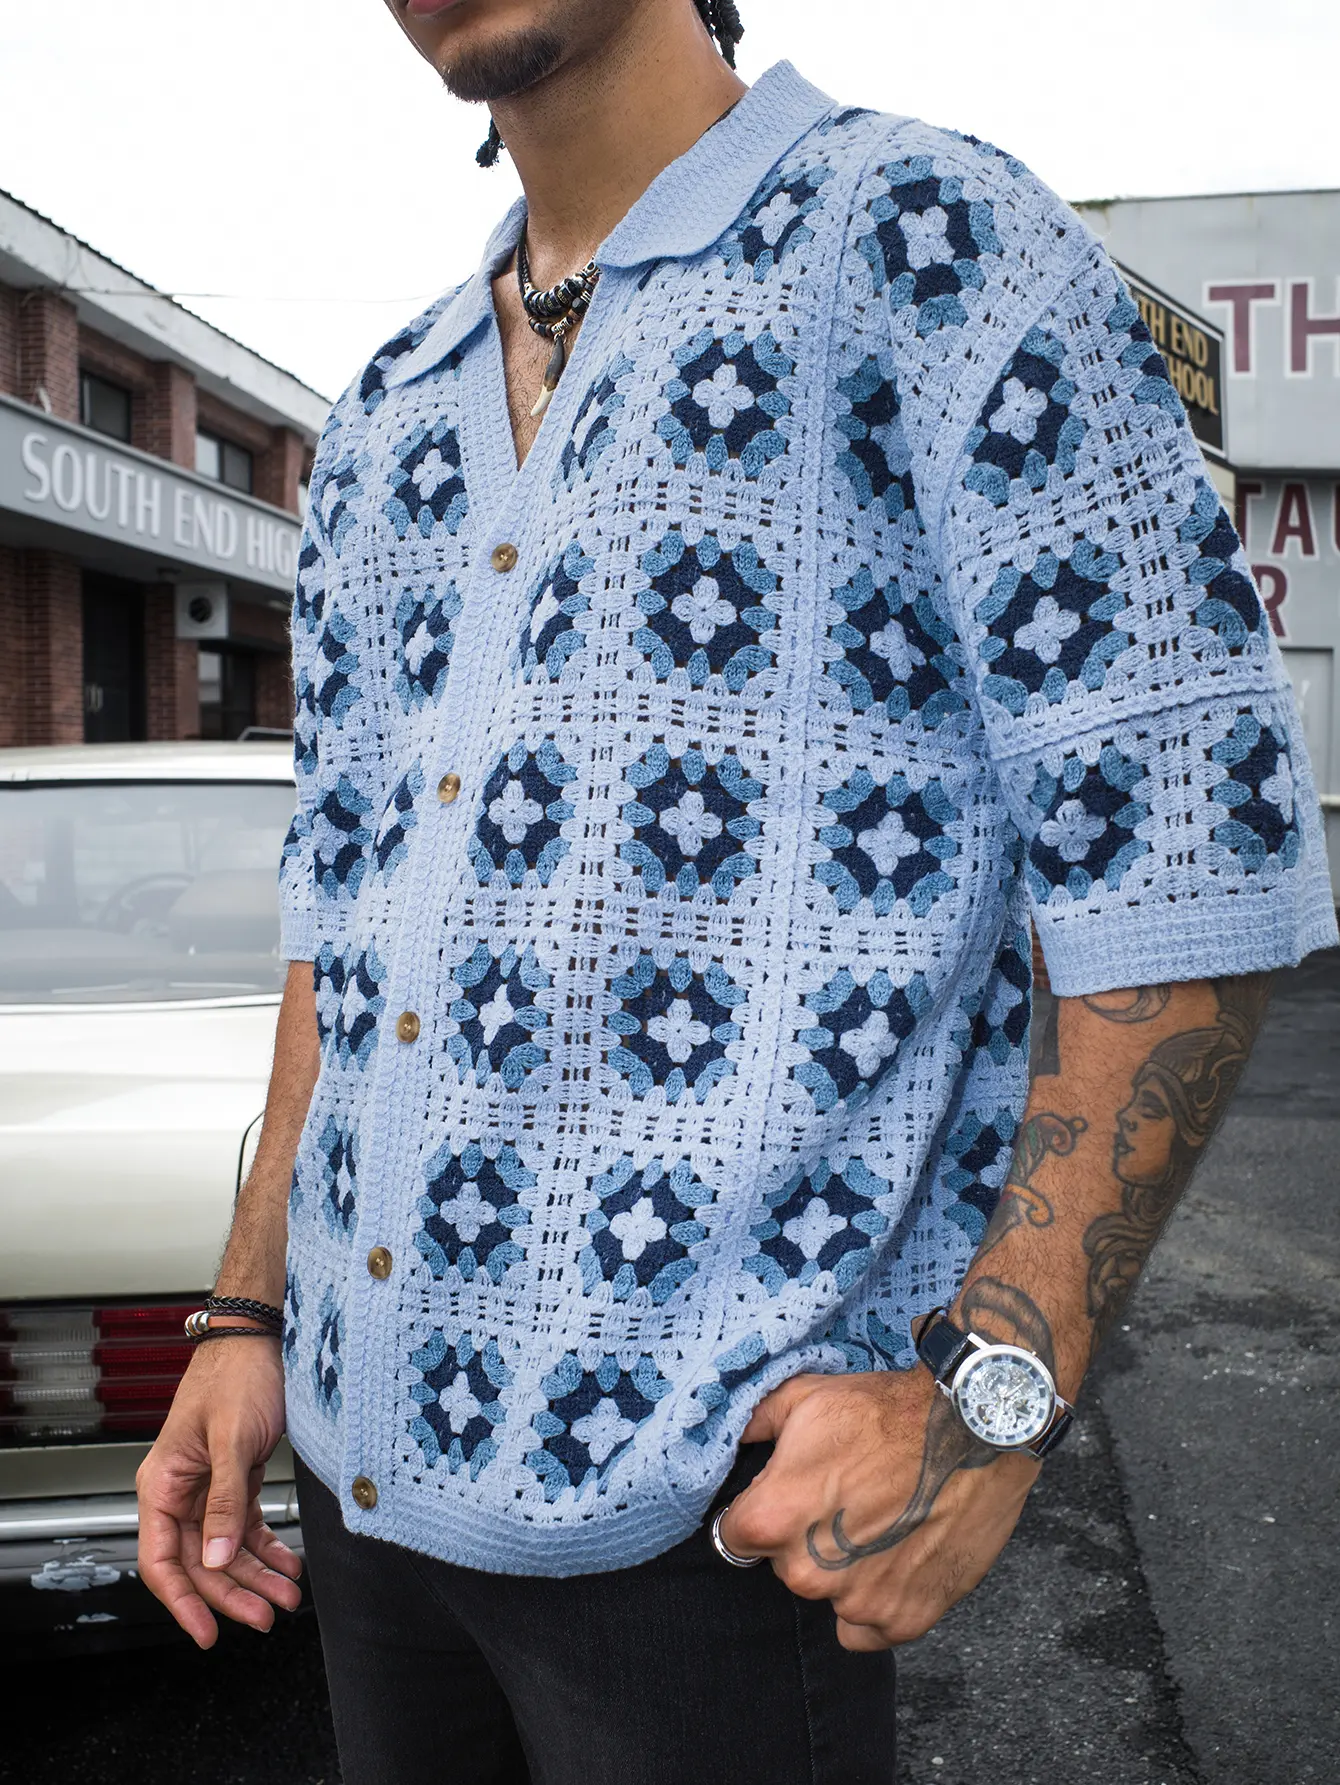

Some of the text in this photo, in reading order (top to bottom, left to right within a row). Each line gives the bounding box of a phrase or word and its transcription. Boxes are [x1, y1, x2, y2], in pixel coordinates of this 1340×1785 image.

[1171, 313, 1208, 368] END
[1161, 349, 1219, 416] HOOL
[22, 432, 162, 538] SOUTH
[174, 488, 238, 560] END
